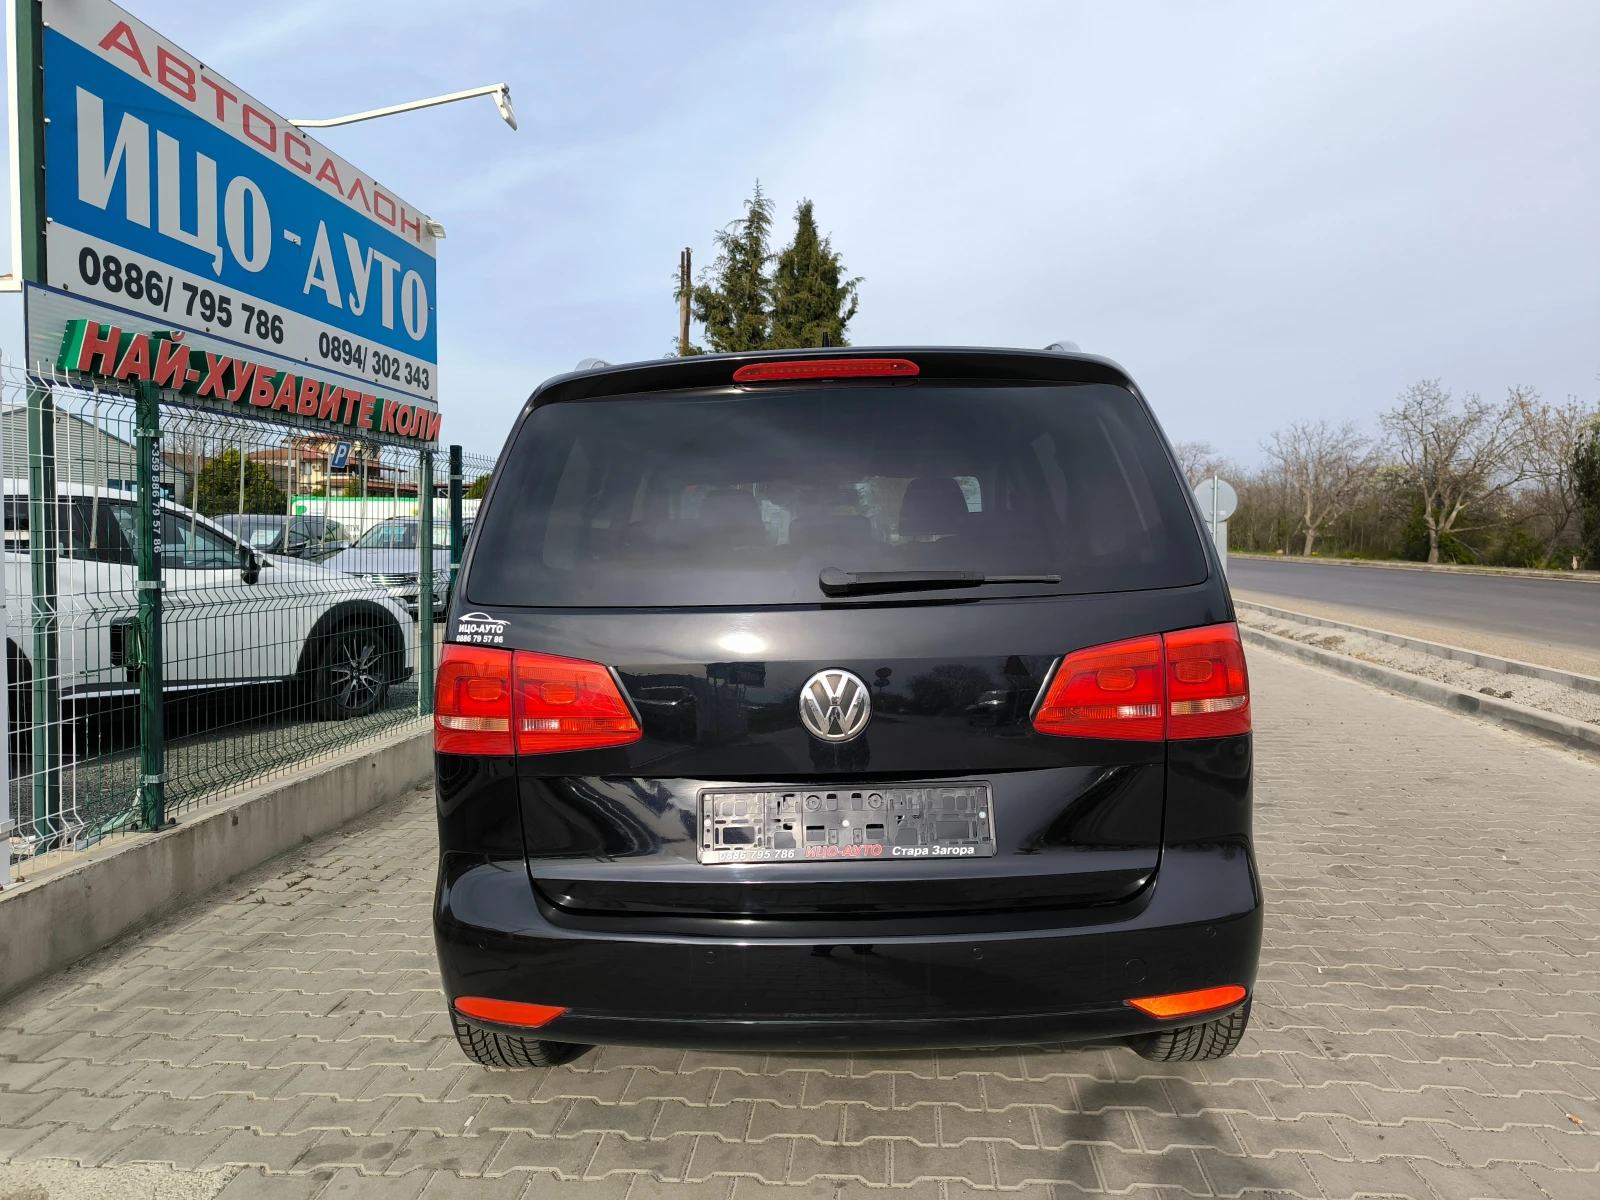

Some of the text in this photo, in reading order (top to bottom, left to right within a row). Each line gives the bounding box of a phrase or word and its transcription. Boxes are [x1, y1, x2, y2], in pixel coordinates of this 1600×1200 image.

[98, 20, 421, 244] АВТОСАЛОН
[78, 246, 284, 344] 0886/ 795 786
[318, 331, 430, 391] 0894/ 302 343
[75, 319, 443, 443] НАЙ-ХУБАВИТЕ КОЛИ
[335, 445, 347, 464] P
[151, 441, 162, 553] +359 886 79 57 86
[459, 624, 503, 634] ИЦО-АУТО
[719, 848, 795, 860] 0886 795 786
[805, 844, 883, 859] ИЦО-АУТО
[892, 844, 975, 857] Стара Загора
